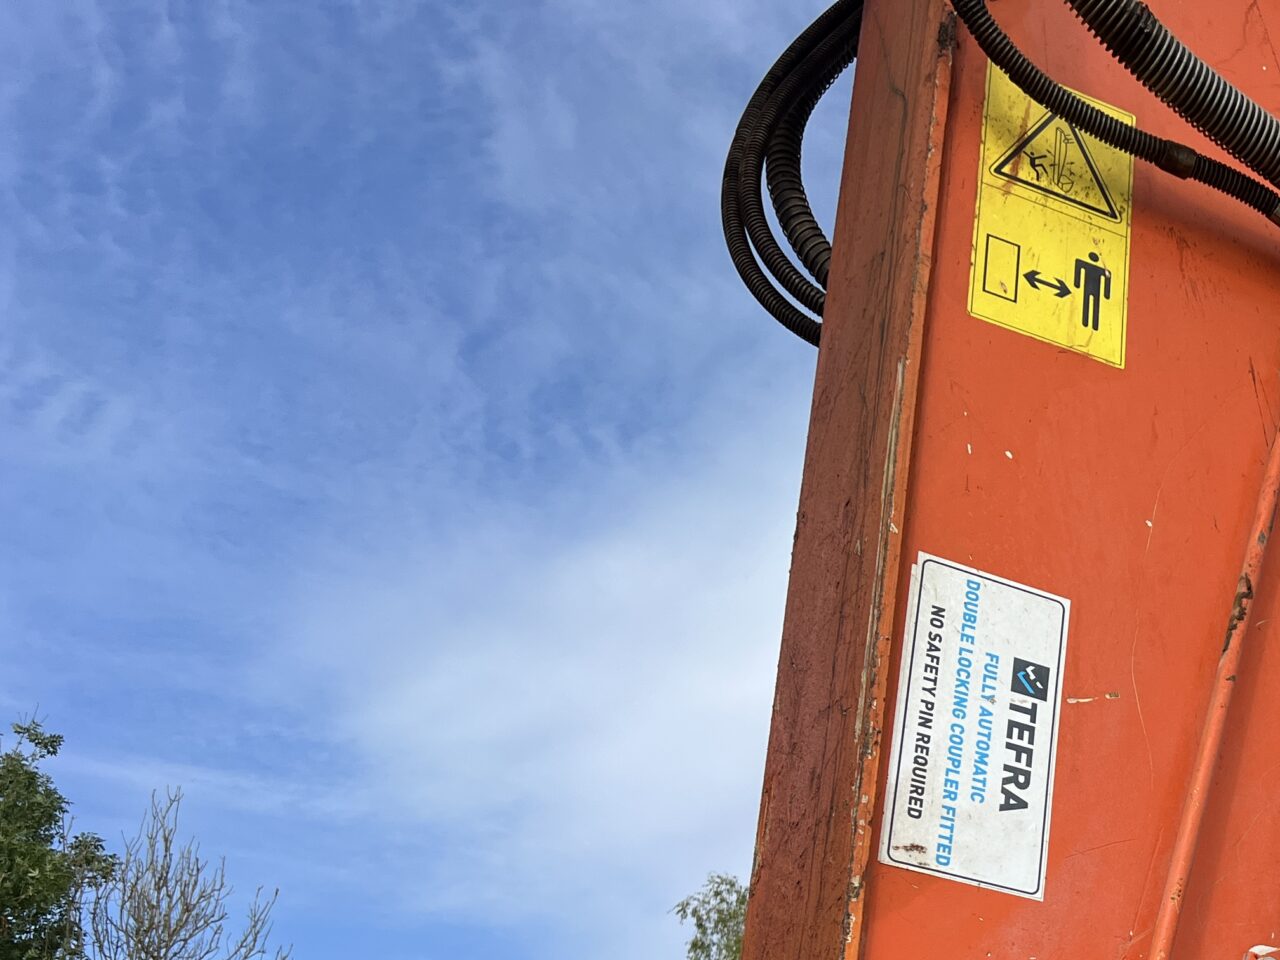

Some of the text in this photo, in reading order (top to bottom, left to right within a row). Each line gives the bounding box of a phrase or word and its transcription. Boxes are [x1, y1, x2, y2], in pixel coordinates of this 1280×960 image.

[908, 605, 945, 819] NO SAFETY PIN REQUIRED
[936, 580, 980, 866] DOUBLE LOCKING COUPLER FITTED
[971, 653, 999, 803] FULLY AUTOMATIC
[999, 703, 1037, 811] TEFRA
